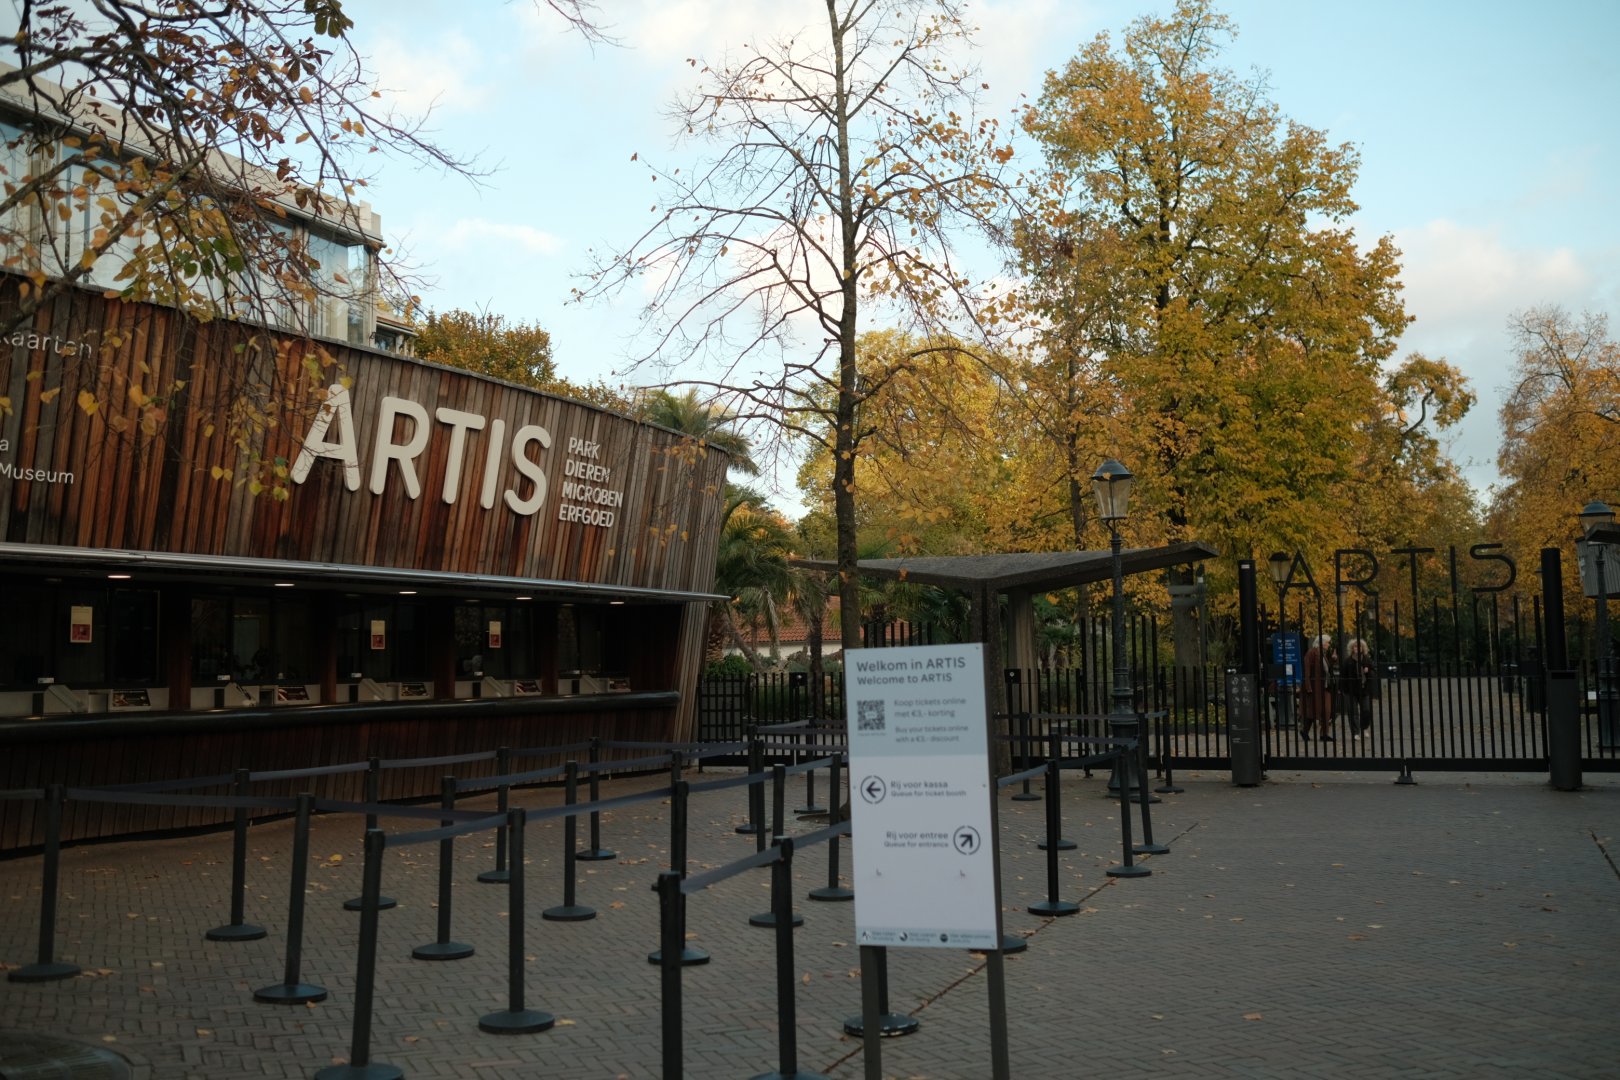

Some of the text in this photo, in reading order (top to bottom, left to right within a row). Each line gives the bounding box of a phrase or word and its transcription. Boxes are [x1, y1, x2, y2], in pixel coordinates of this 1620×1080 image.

[290, 383, 552, 516] ARTIS
[568, 437, 600, 460] PARK
[565, 459, 611, 484] DIEREN
[562, 481, 624, 508] MICROBEN
[559, 504, 615, 528] ERFGOED
[1279, 543, 1517, 598] ARTIS
[856, 657, 966, 672] Welkom in ARTIS
[857, 673, 953, 685] Welcome to ARTIS
[915, 698, 941, 706] tickets
[942, 697, 967, 705] online
[928, 709, 956, 718] korting
[890, 780, 902, 790] Rij
[886, 831, 897, 840] Rij
